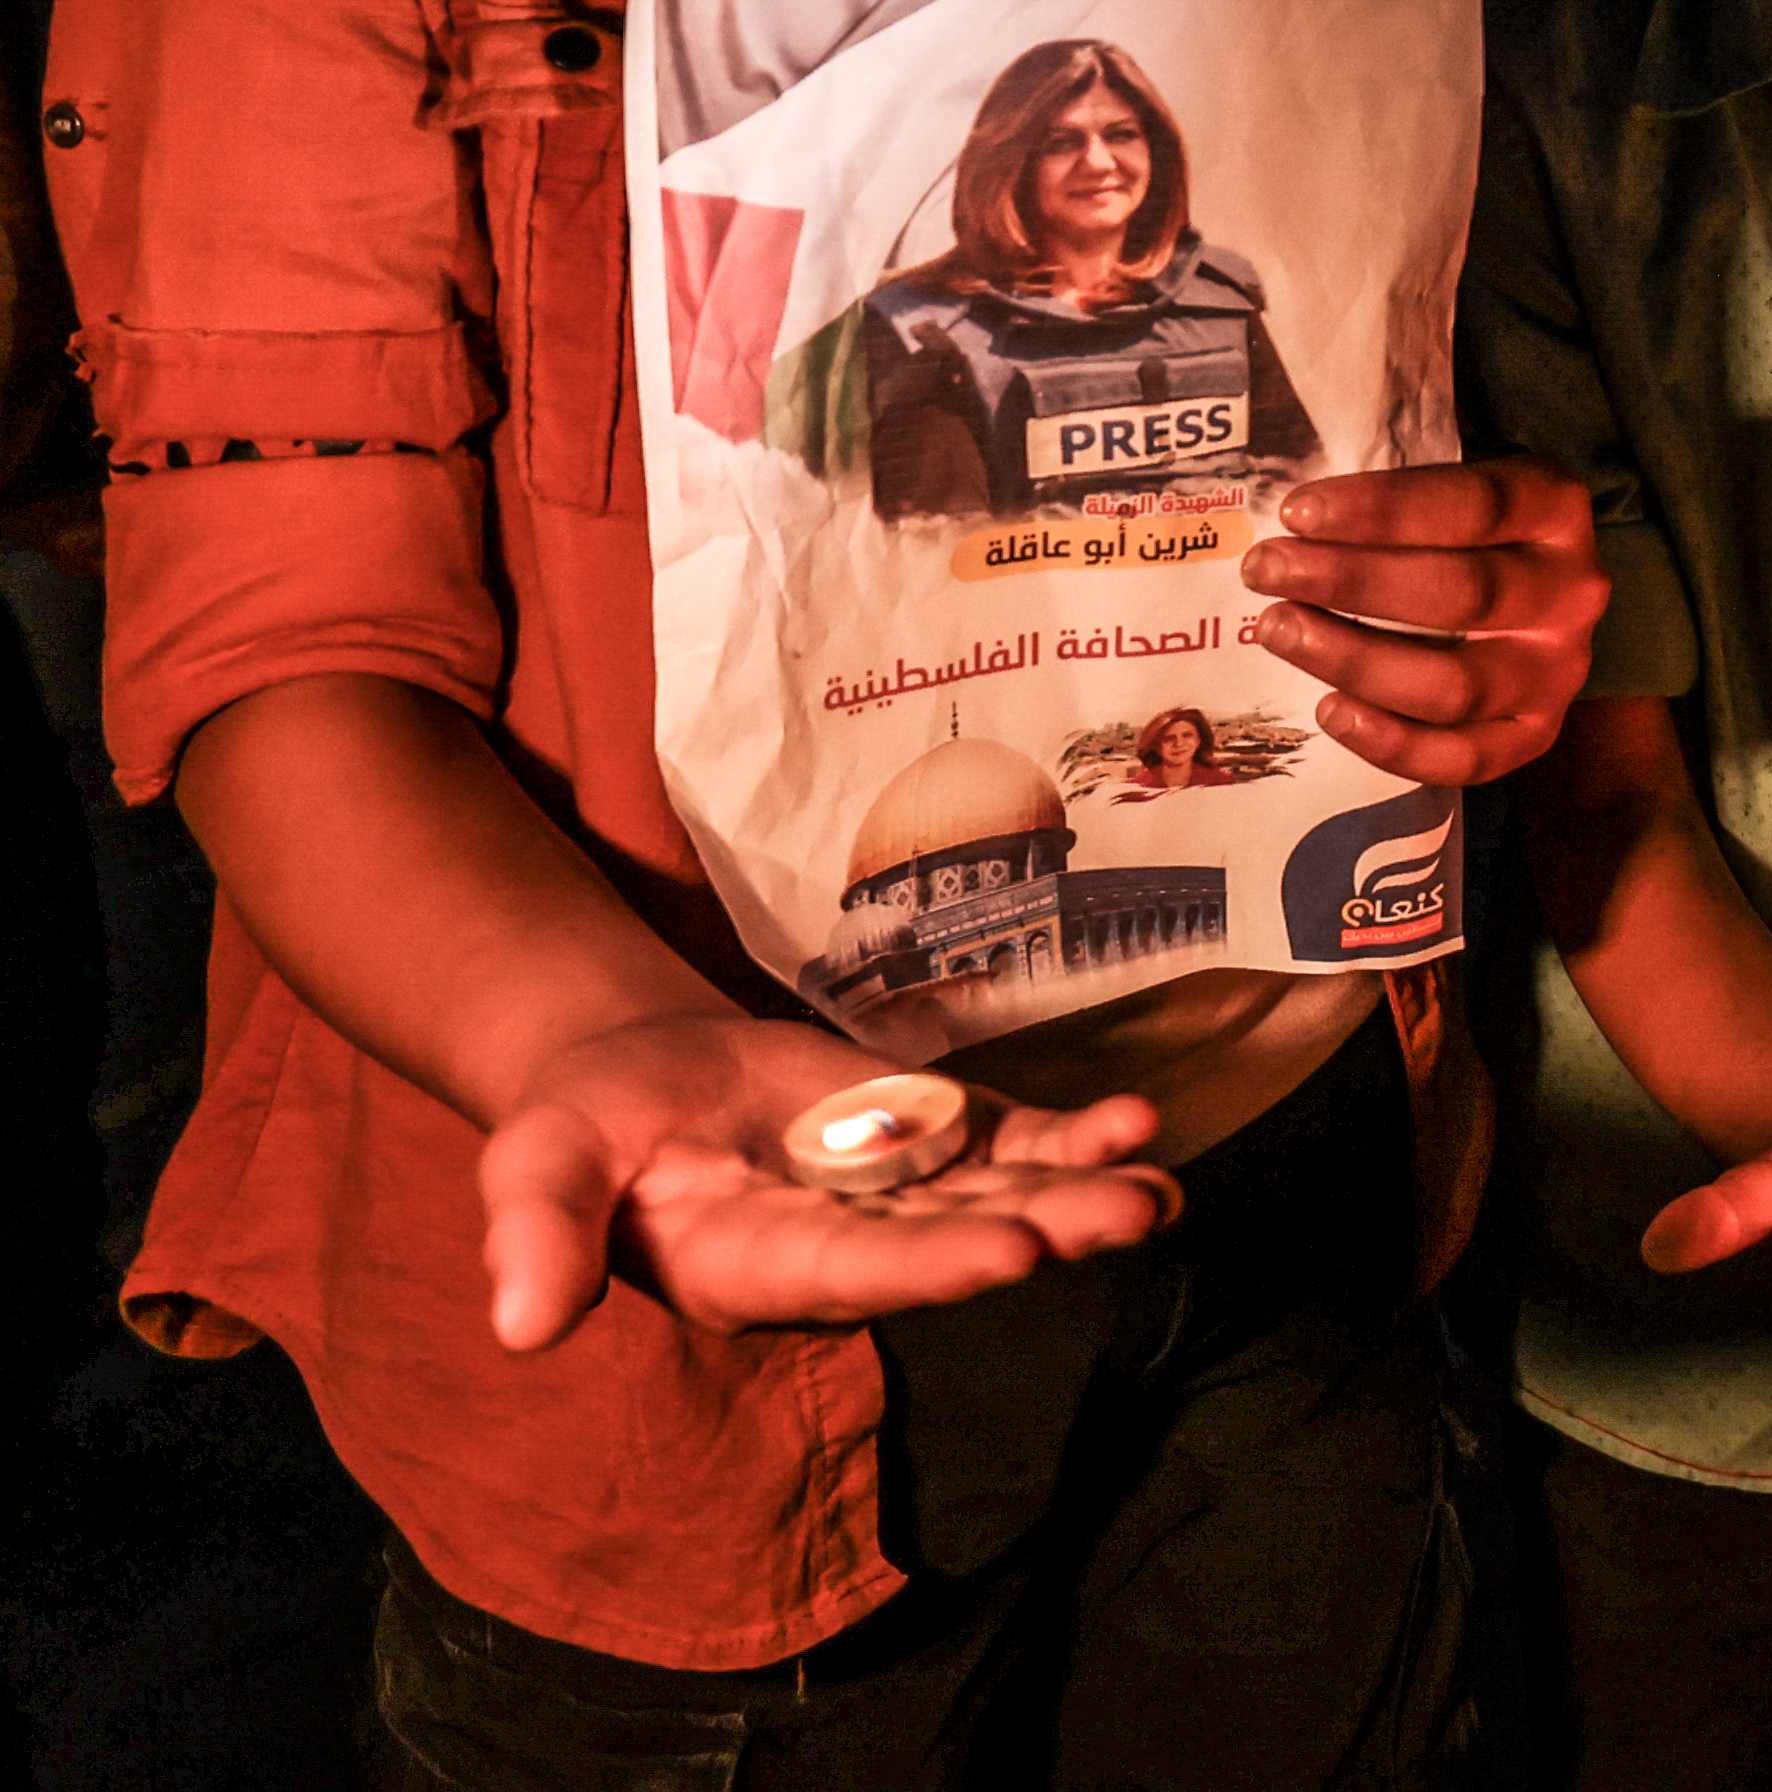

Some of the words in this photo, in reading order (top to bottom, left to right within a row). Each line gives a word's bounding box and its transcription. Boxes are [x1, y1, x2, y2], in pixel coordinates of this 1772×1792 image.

[1060, 403, 1234, 465] PRESS
[1161, 488, 1244, 514] الشهيدة
[985, 531, 1071, 566] عاقلة
[1083, 522, 1127, 565] أبو
[1138, 521, 1219, 561] شرين
[1056, 616, 1221, 660] الصحافة
[823, 631, 1039, 716] الفلسطينية
